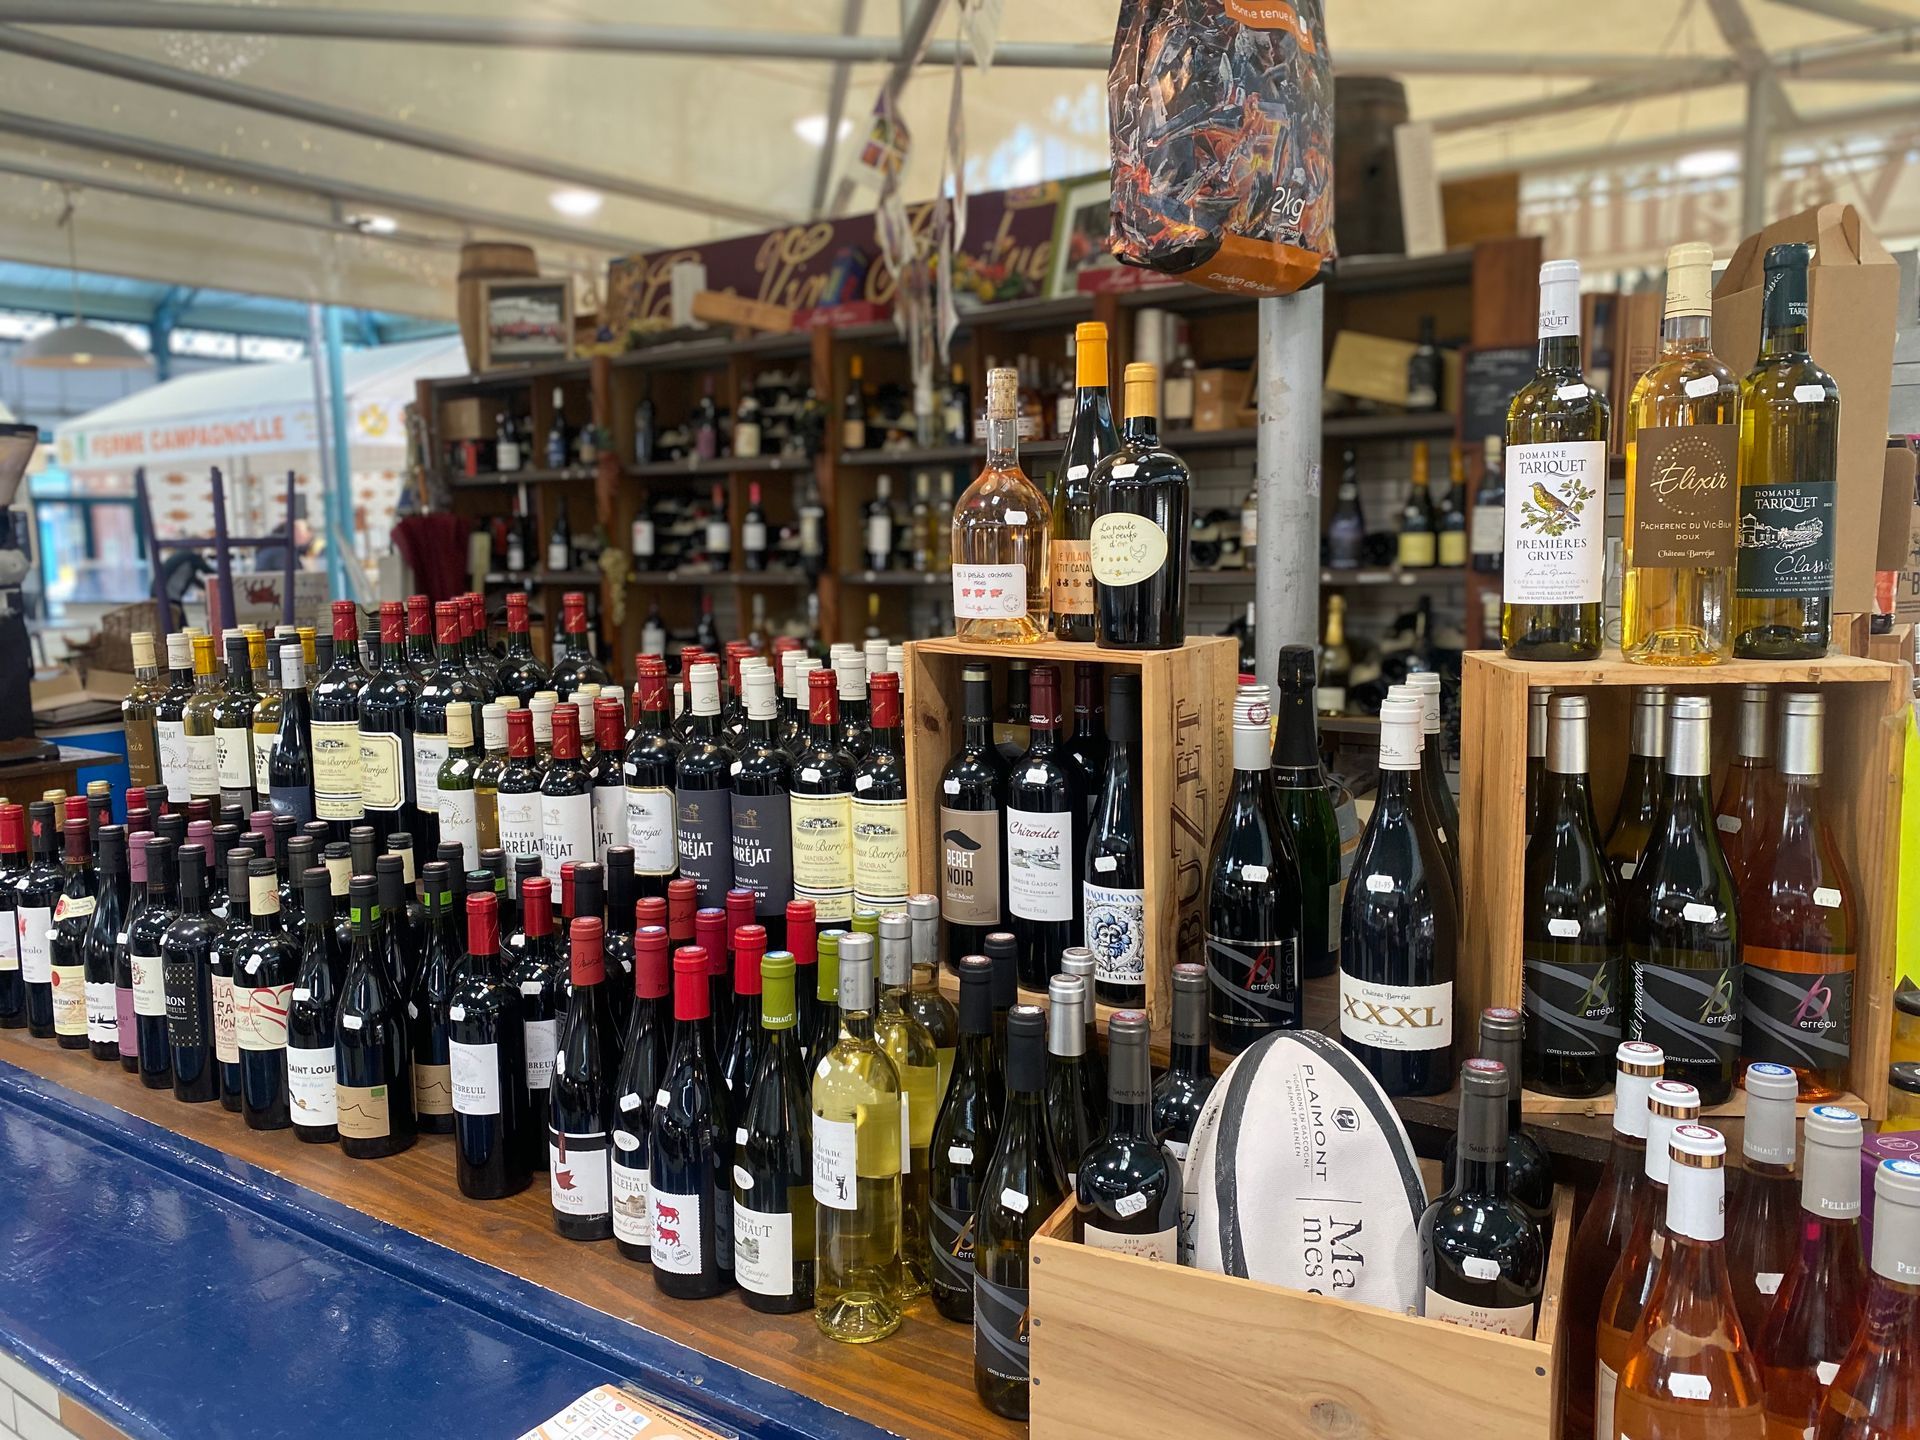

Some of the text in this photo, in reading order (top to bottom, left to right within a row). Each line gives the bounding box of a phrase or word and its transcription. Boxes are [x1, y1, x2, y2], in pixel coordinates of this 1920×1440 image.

[1260, 9, 1289, 21] tenue
[1271, 186, 1306, 226] 2kg
[91, 416, 285, 458] FERME CAMPAGNOLLE
[1519, 451, 1567, 460] DOMAINE
[1519, 459, 1586, 478] TARIQUET
[1650, 462, 1728, 495] Elixir
[1755, 489, 1801, 497] DOMAINE
[1755, 496, 1818, 512] TARIQUET
[1112, 522, 1136, 533] poule
[1516, 538, 1587, 549] PREMIÈRES
[1527, 551, 1574, 561] GRIVES
[1657, 550, 1686, 558] Château
[1070, 563, 1091, 572] CANA
[1774, 555, 1834, 575] Classic
[1009, 821, 1060, 839] Chiroulet
[1170, 698, 1208, 951] BUZET
[501, 838, 545, 855] ARRÉJAT
[946, 848, 975, 869] BERET
[947, 867, 974, 887] NOIR
[1343, 993, 1444, 1028] XXXL
[1302, 1064, 1327, 1182] PLAIMONT
[1301, 1124, 1311, 1169] GASCOGNE
[1821, 1198, 1861, 1211] PELLEHA
[735, 1215, 773, 1238] LEHAUT
[1470, 1310, 1489, 1318] 2019
